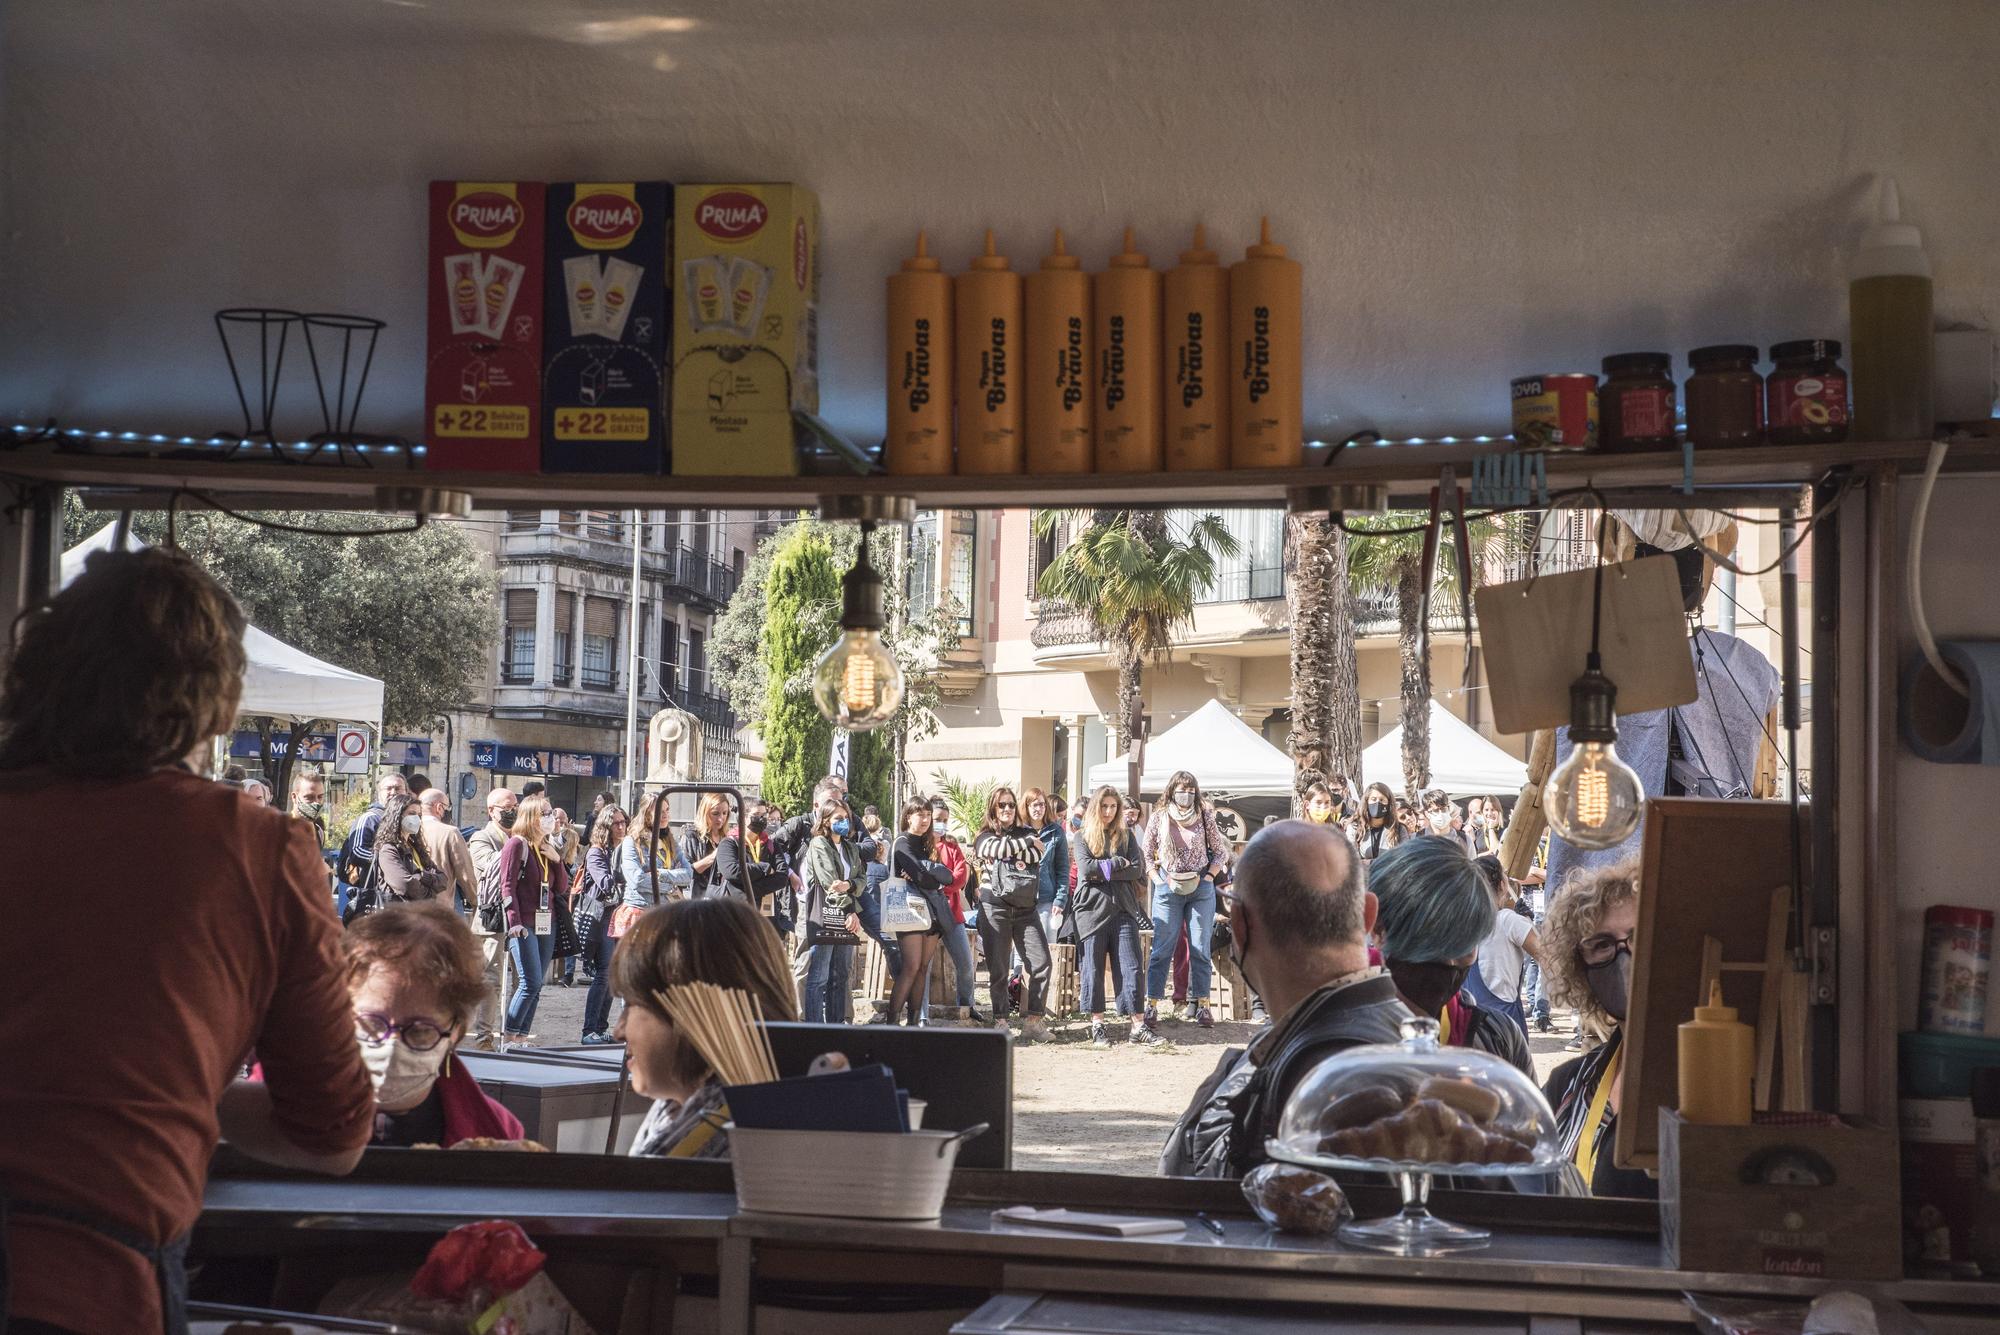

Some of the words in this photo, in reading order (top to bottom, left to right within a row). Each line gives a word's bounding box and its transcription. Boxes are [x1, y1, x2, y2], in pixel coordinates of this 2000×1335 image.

[455, 204, 516, 231] PRIMA
[574, 206, 634, 233] PRIMA
[700, 204, 762, 231] PRIMA
[909, 318, 930, 412] Bravas
[986, 317, 1007, 412] Bravas
[1063, 316, 1082, 411] Bravas
[1106, 315, 1125, 410] Bravas
[1183, 312, 1203, 408] Bravas
[1249, 306, 1270, 403] Bravas
[1512, 382, 1542, 398] OYA
[476, 754, 493, 762] MGS
[514, 755, 538, 769] MGS
[1763, 1256, 1822, 1274] london
